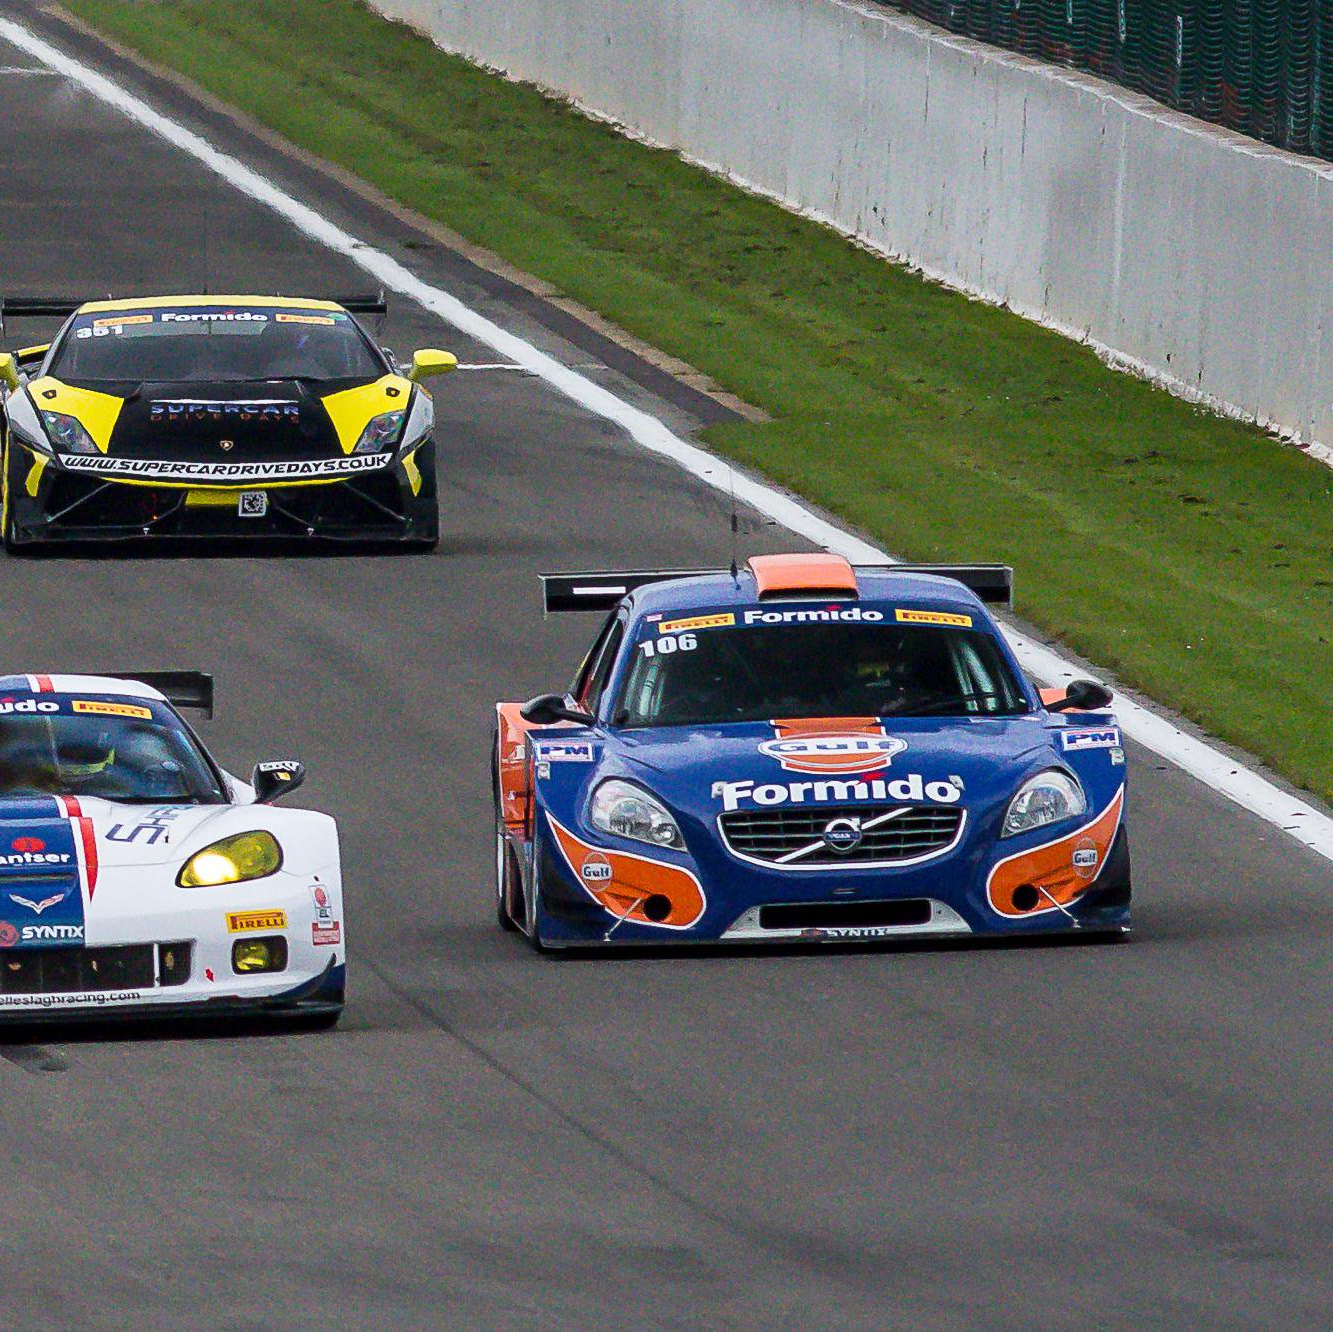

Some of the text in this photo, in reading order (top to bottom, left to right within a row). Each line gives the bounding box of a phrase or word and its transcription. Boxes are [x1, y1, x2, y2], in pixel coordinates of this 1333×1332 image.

[161, 312, 269, 322] Formido
[150, 404, 300, 415] SUPERCAR
[63, 454, 388, 476] WWW.SUPERCARDRIVEDAYS.CO.UK
[744, 607, 884, 625] Formido
[638, 633, 698, 658] 106
[78, 702, 149, 719] PIRELLI
[1067, 732, 1116, 744] PM
[768, 740, 898, 751] Gulf
[722, 773, 962, 811] Formido
[1073, 852, 1096, 864] Gulf
[583, 865, 611, 877] Gulf
[230, 911, 286, 930] PIRELLI
[21, 925, 85, 939] SYNTIX
